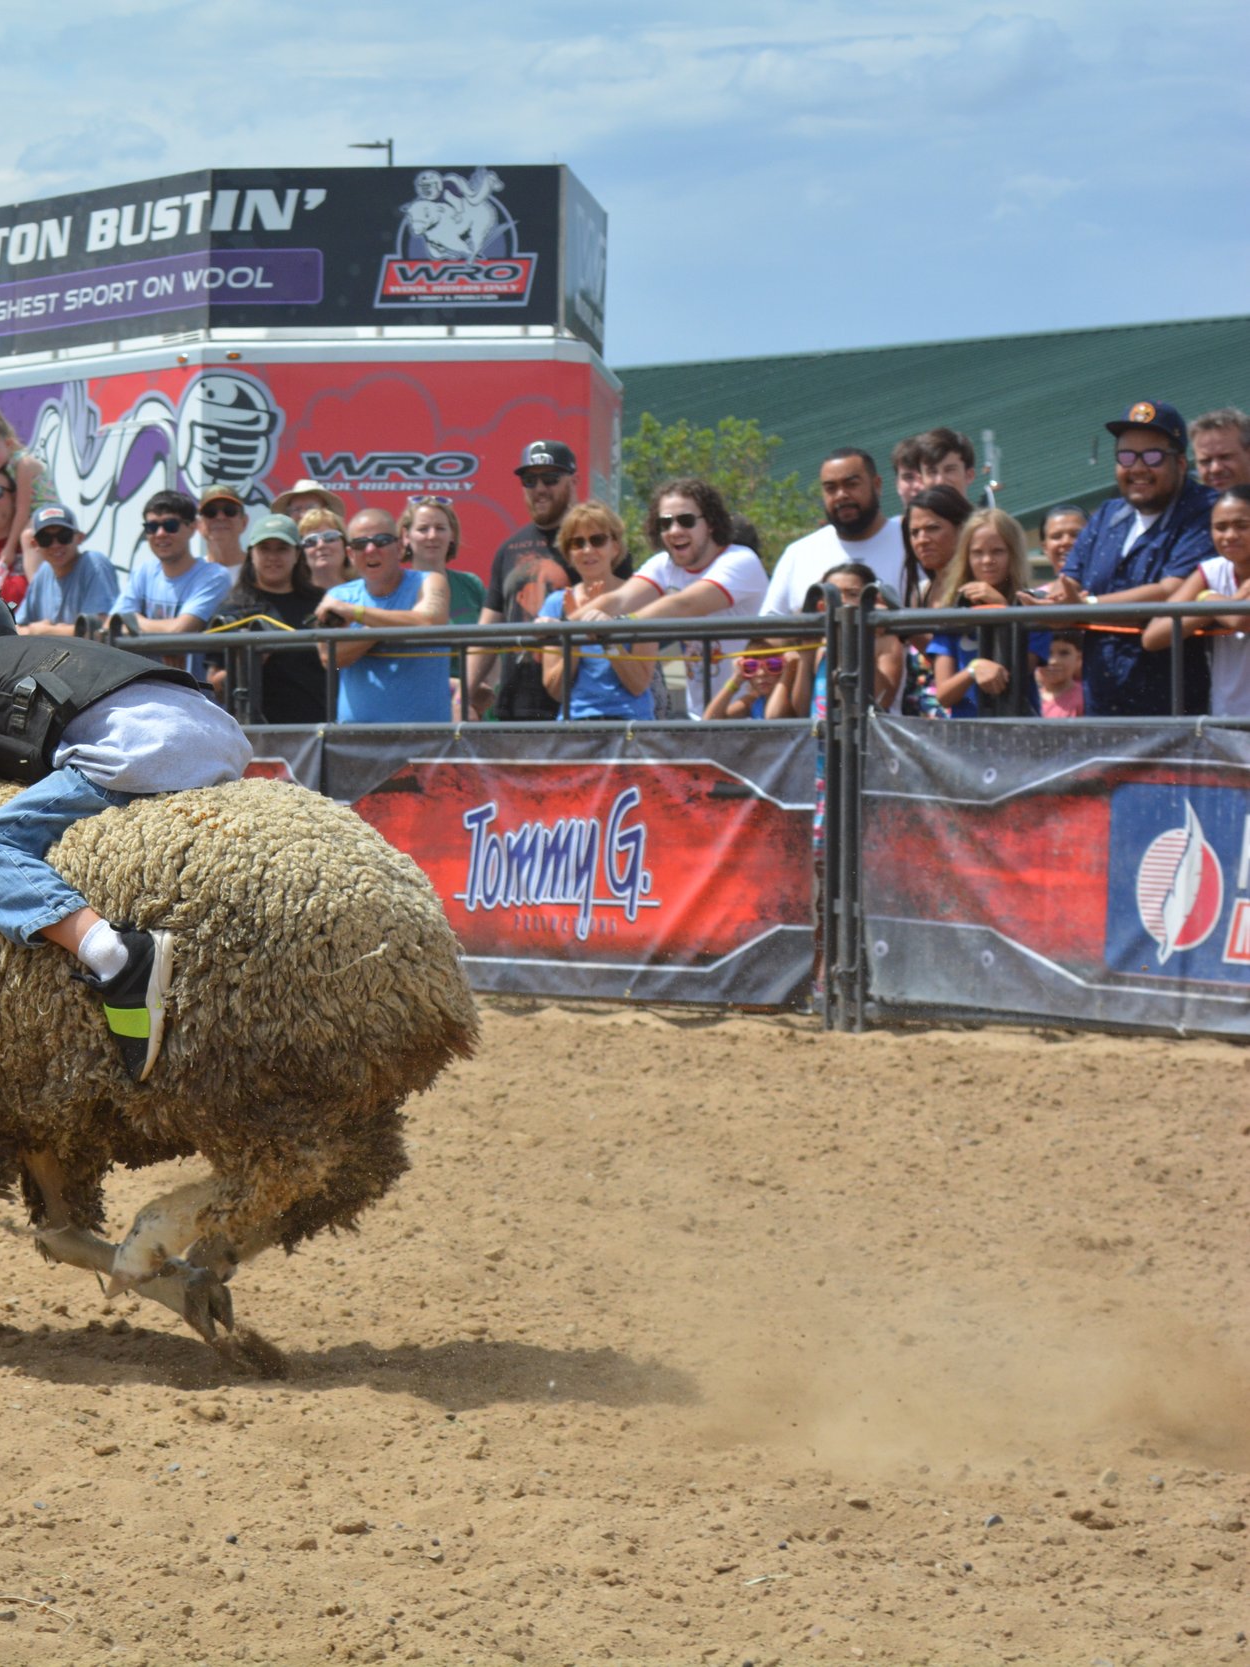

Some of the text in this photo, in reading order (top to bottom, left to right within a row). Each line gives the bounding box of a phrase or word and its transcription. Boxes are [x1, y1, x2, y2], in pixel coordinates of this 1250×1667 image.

[394, 262, 524, 285] WRO
[63, 279, 138, 312] SPORT
[143, 273, 174, 298] ON
[182, 266, 274, 293] WOOL
[301, 452, 479, 480] WRO
[321, 482, 474, 491] OOL RIDERS ONLY
[464, 785, 652, 940] Tommy G.
